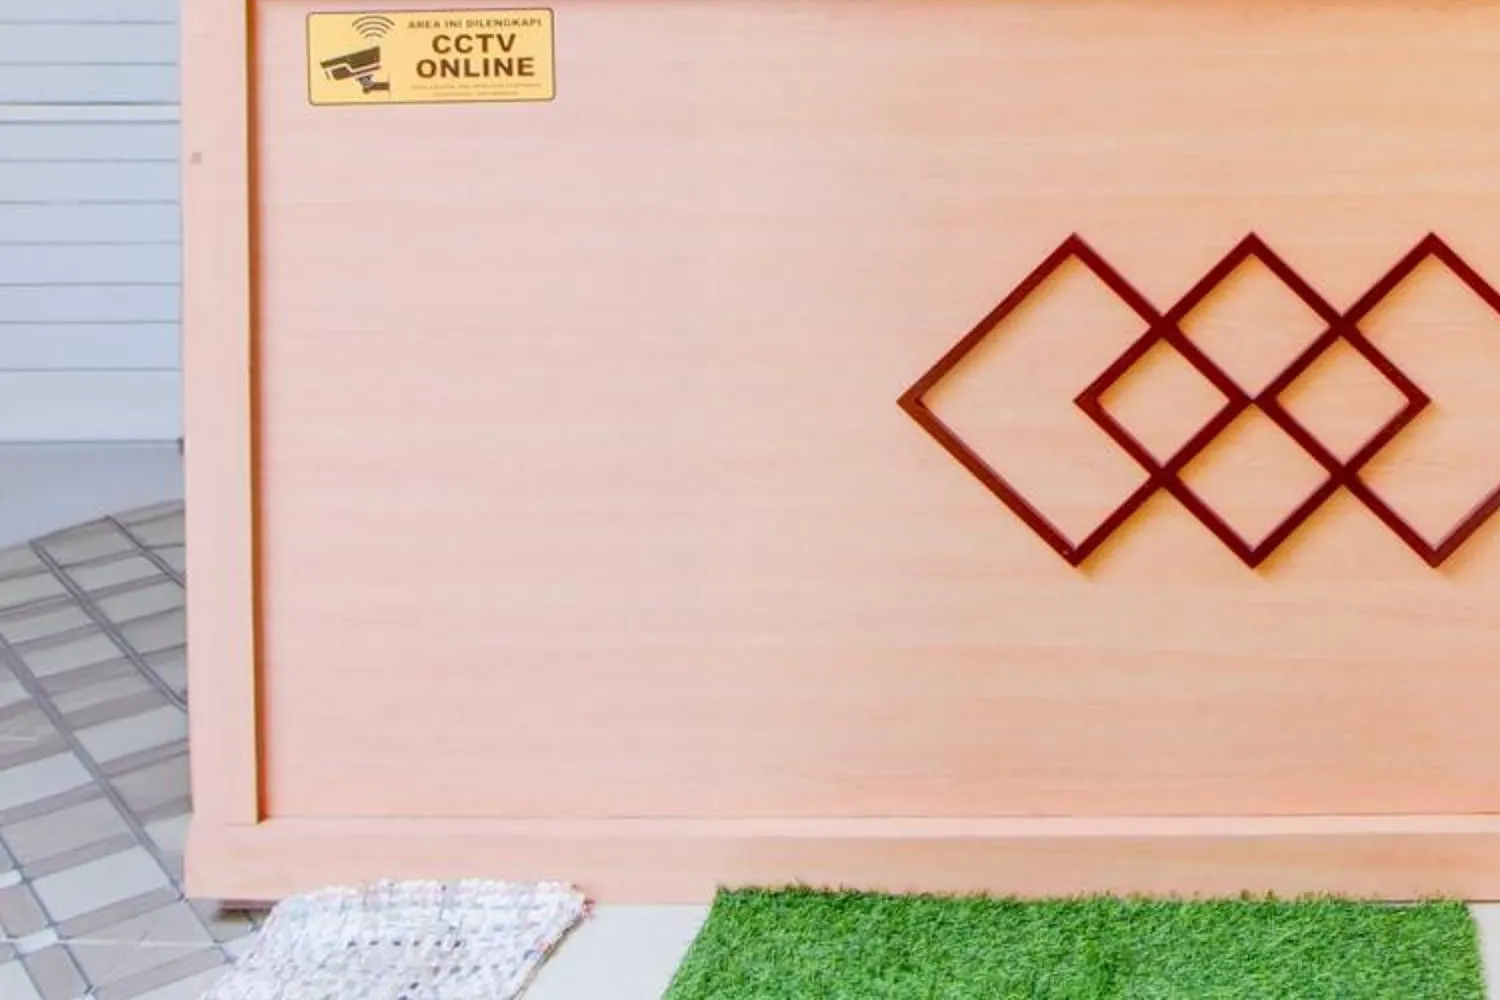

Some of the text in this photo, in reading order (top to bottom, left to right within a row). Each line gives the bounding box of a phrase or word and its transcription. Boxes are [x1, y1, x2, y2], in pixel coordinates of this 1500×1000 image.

[408, 18, 542, 29] AREA INI DILENGKAPI
[431, 33, 516, 55] CCTV
[416, 56, 535, 79] ONLINE
